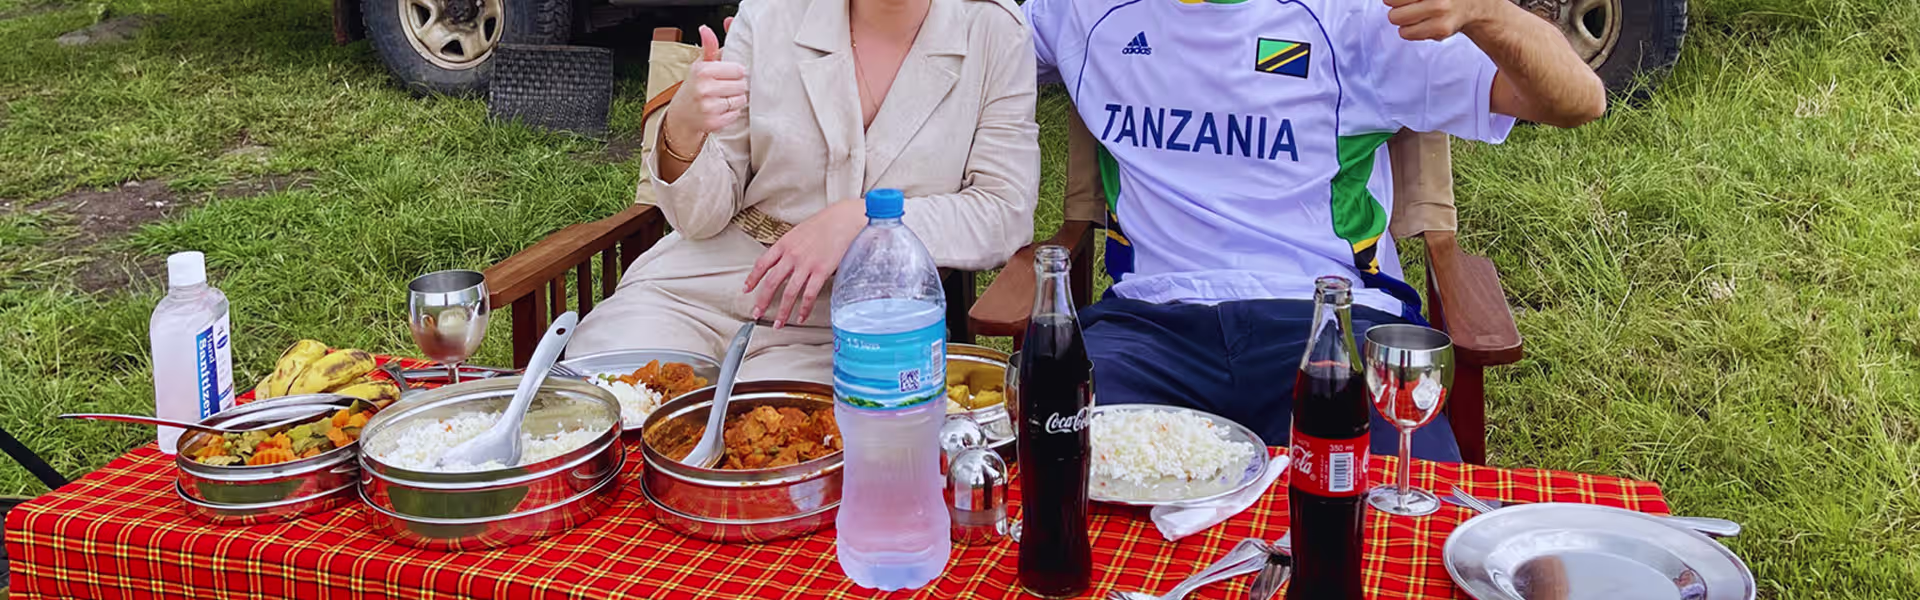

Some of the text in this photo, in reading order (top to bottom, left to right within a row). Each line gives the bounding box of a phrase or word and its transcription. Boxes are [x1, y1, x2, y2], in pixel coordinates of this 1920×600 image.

[1121, 45, 1152, 55] adidas
[1101, 104, 1299, 162] TANZANIA
[207, 332, 216, 363] Hand
[199, 338, 211, 417] Sanitizer
[1045, 407, 1089, 434] Coca-Col
[1329, 444, 1344, 452] 350
